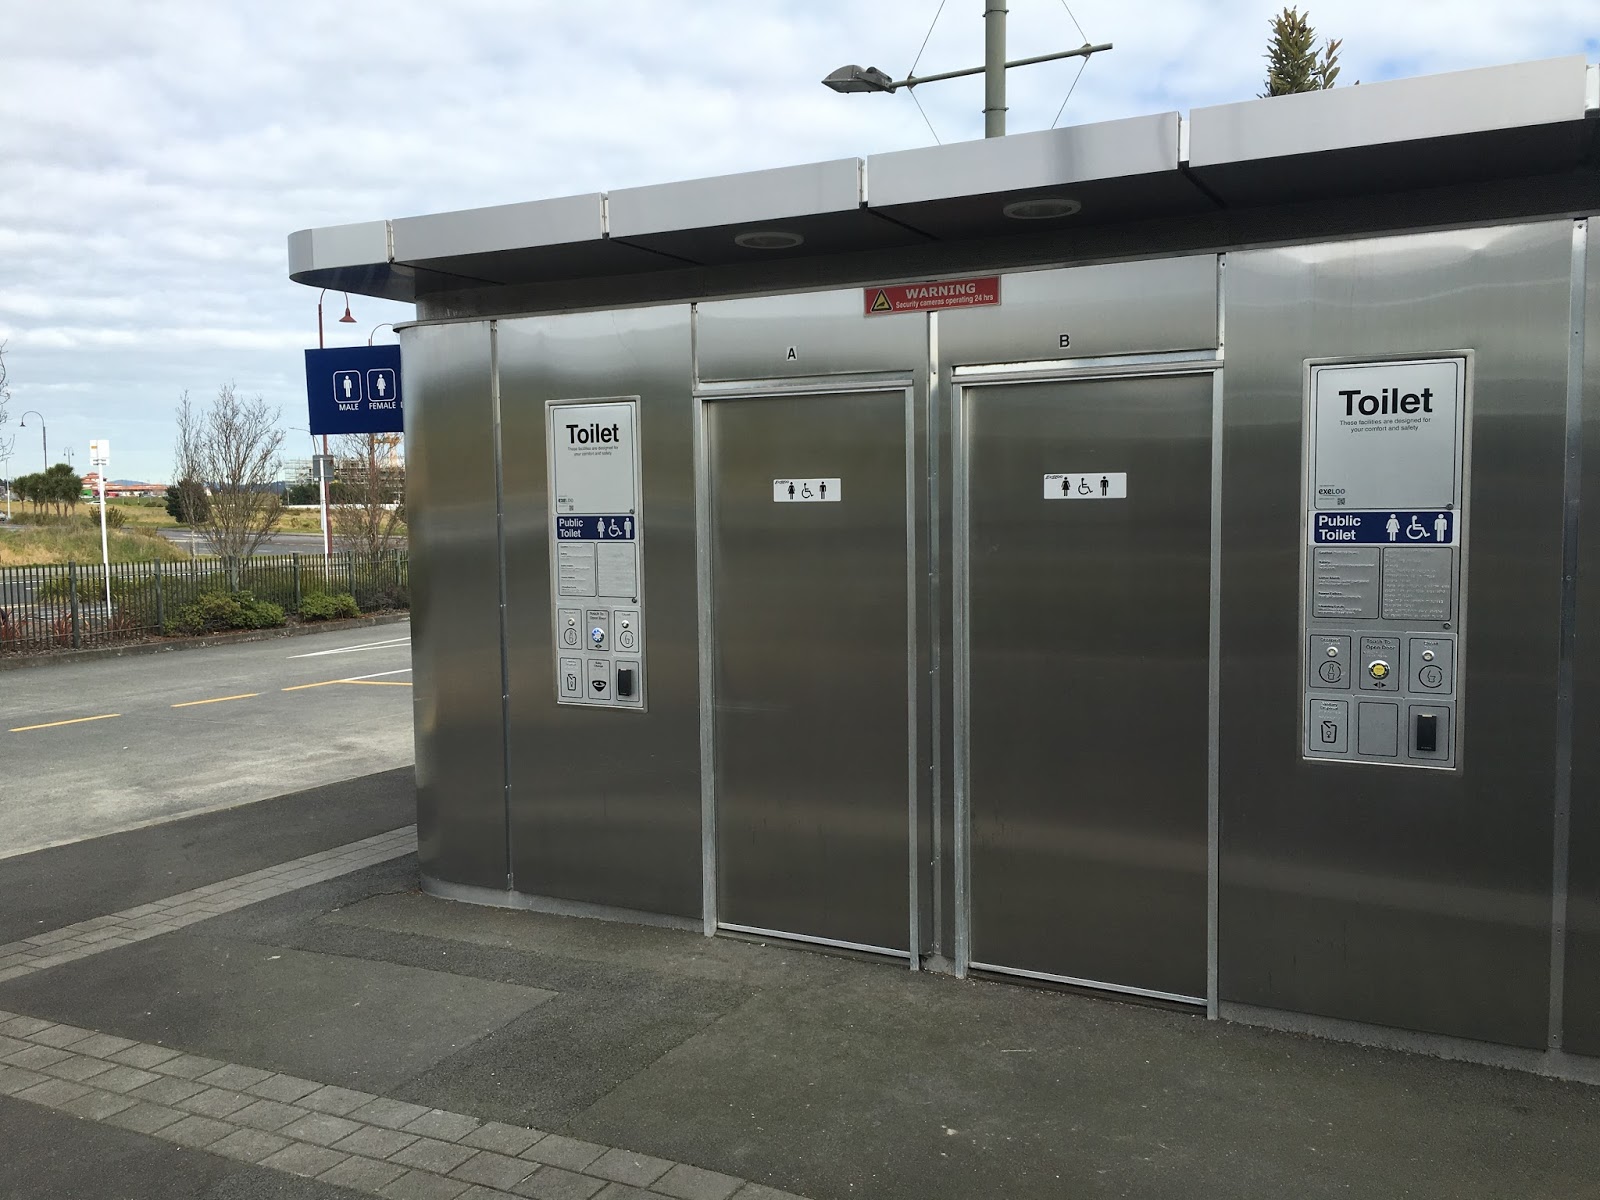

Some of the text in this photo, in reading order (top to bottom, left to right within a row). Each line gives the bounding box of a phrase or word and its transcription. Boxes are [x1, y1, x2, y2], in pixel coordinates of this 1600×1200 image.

[905, 283, 976, 299] WARNING
[895, 293, 994, 309] Security cameras operating 24 hrs
[1059, 334, 1070, 347] B
[787, 347, 797, 360] A
[339, 403, 359, 411] MALE
[369, 402, 396, 410] FEMALE
[1338, 387, 1433, 416] Toilet
[1394, 417, 1421, 425] designed
[565, 423, 619, 444] Toilet
[559, 517, 583, 527] Public
[1318, 515, 1361, 527] Public
[559, 528, 581, 538] Toilet
[1319, 529, 1357, 541] Toilet
